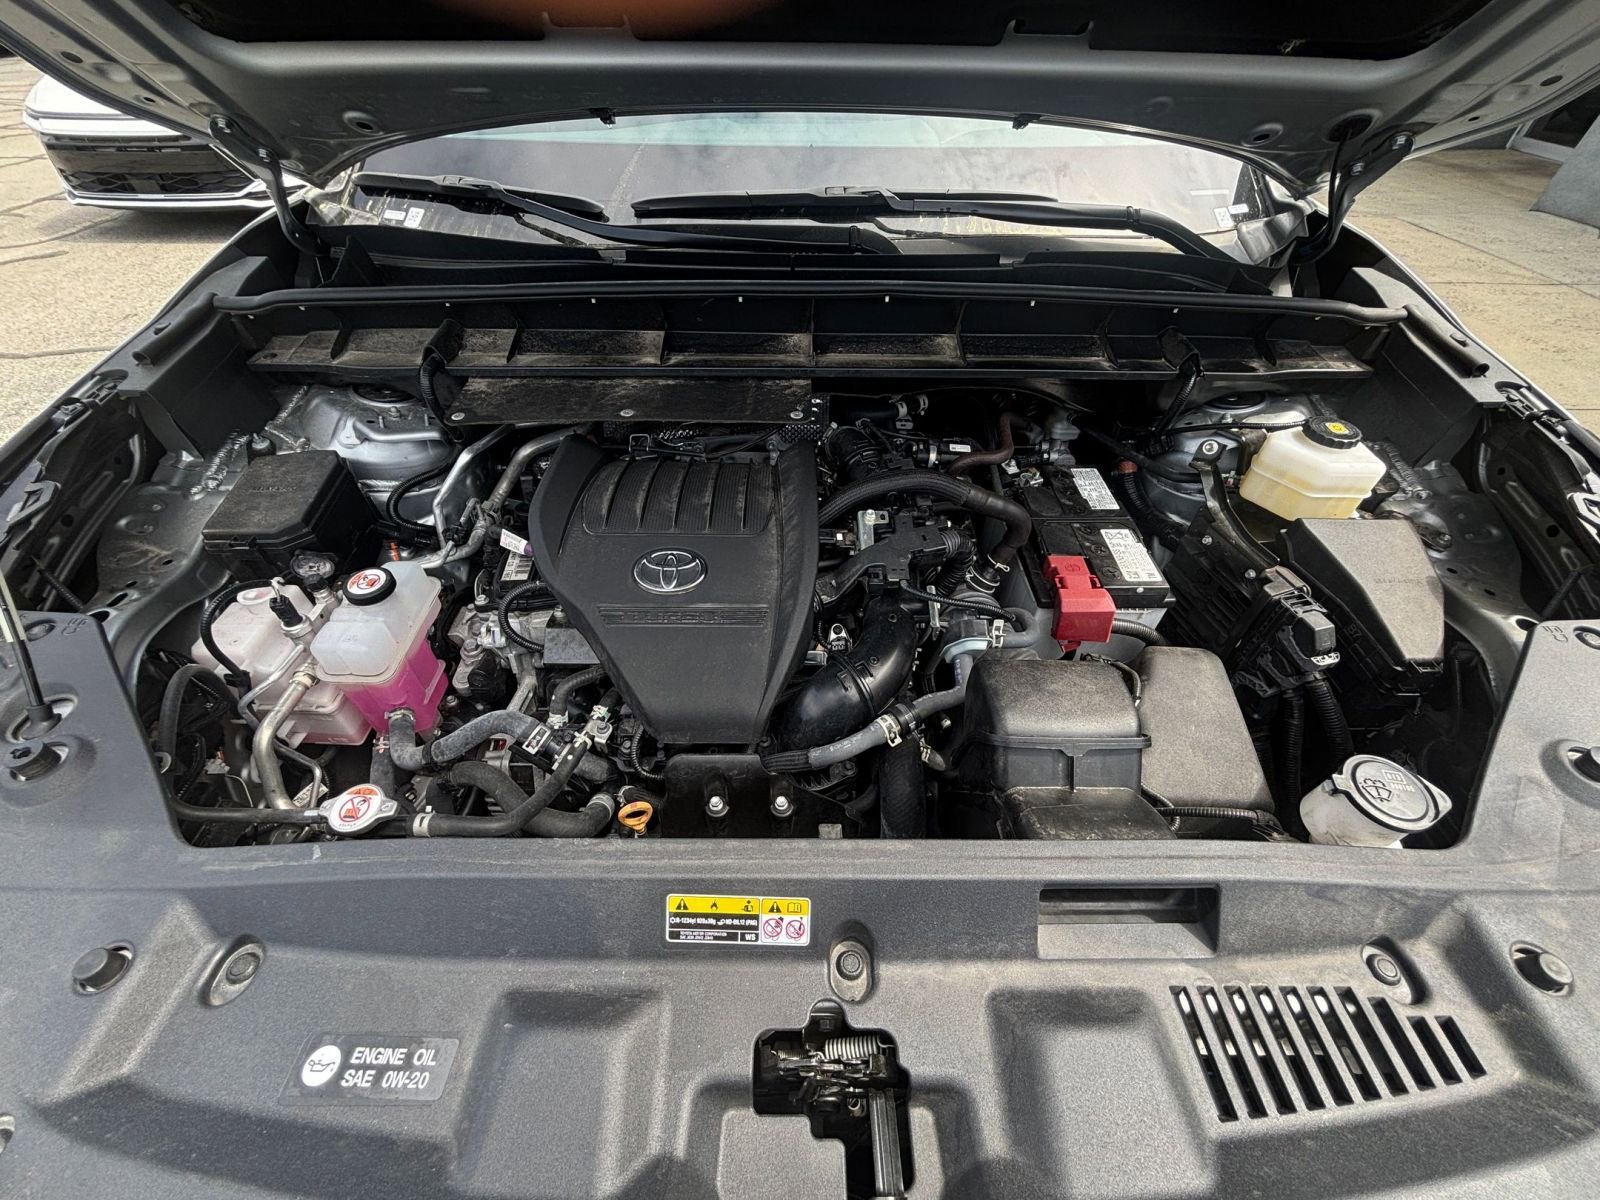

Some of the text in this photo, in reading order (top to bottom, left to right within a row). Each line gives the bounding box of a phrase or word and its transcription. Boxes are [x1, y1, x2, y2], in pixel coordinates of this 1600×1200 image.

[350, 1046, 437, 1066] ENGINE OIL
[340, 1069, 430, 1089] SAE 0W-20
